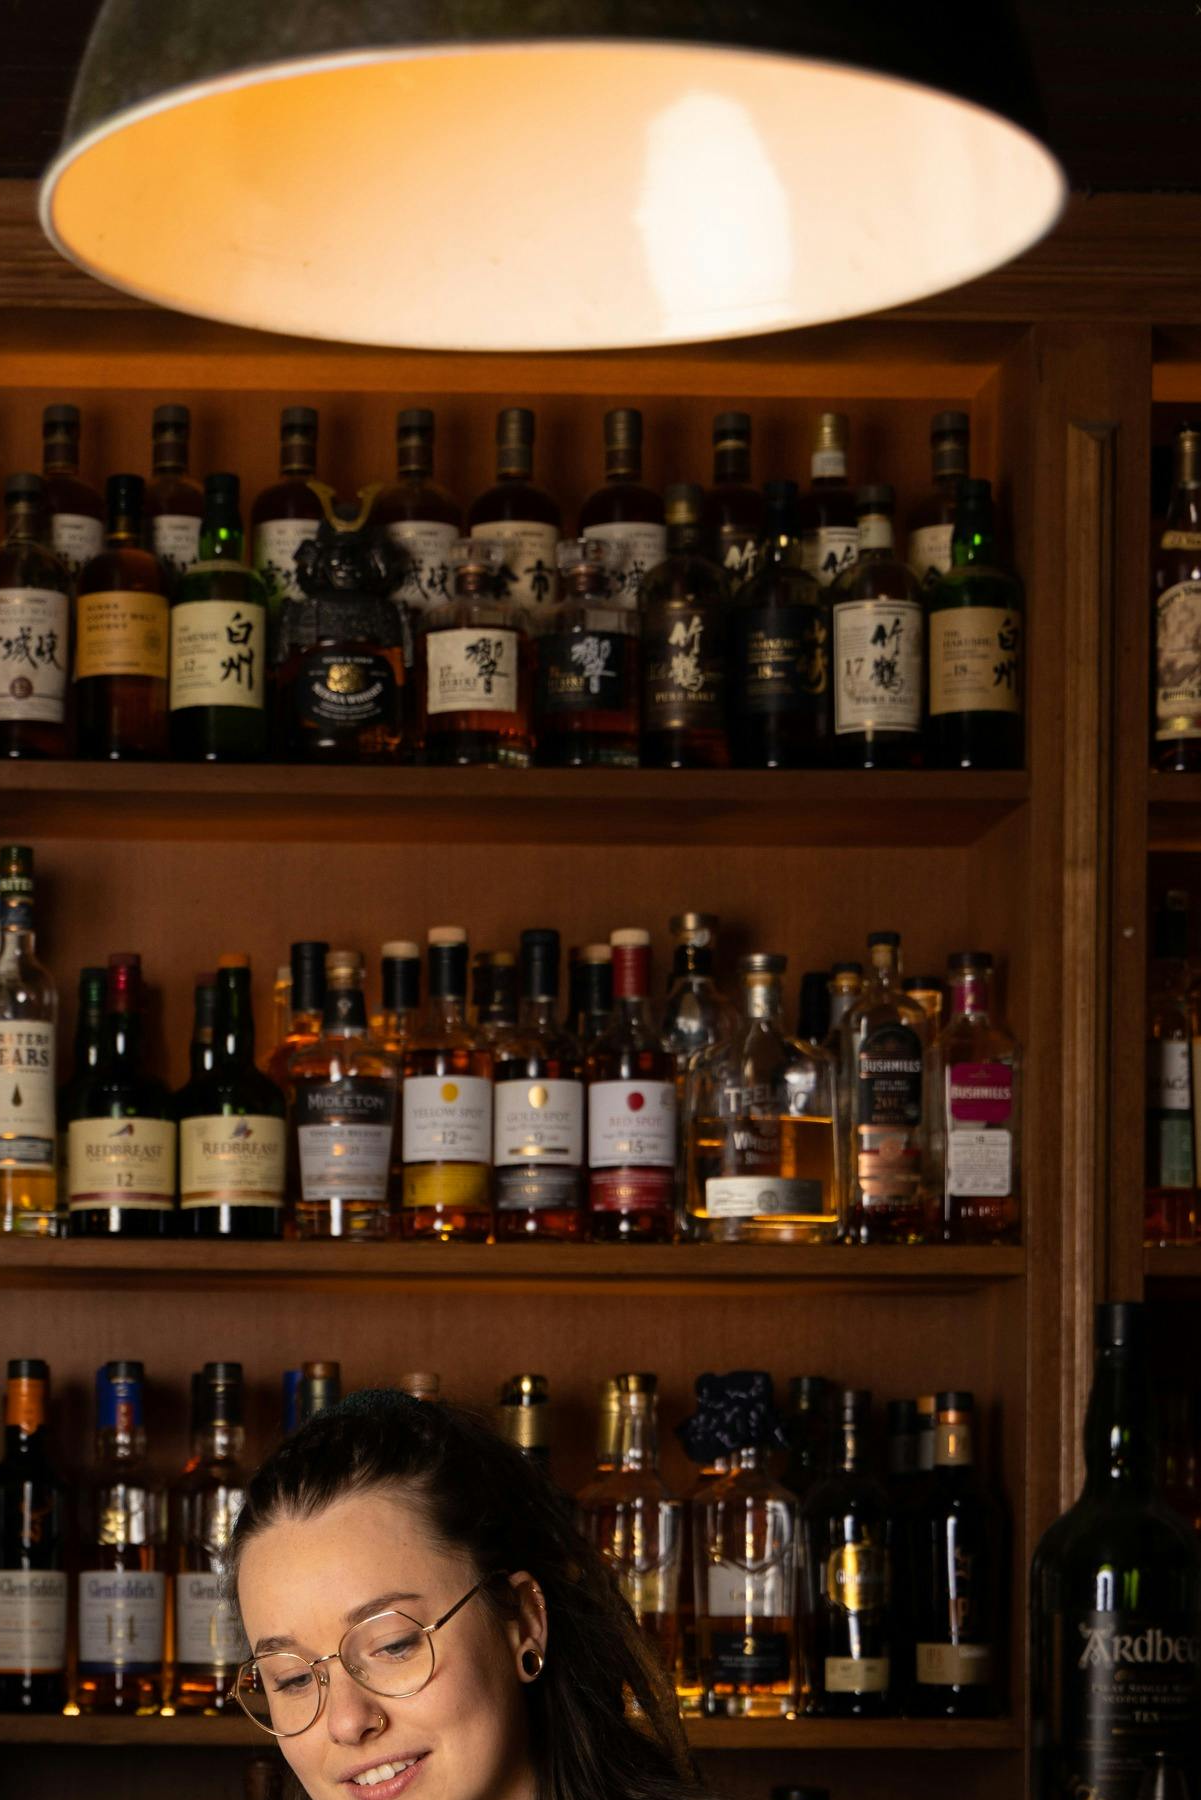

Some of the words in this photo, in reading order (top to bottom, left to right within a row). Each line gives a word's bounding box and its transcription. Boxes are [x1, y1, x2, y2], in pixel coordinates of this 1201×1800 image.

[220, 612, 255, 691] 白州
[844, 657, 865, 677] 17
[861, 1059, 922, 1073] BUSHMILLS
[307, 1090, 384, 1110] MIDLETON
[950, 1086, 1011, 1101] BUSHMILLS
[411, 1108, 453, 1119] YELLOW
[455, 1108, 485, 1119] SPOT
[507, 1111, 540, 1122] GOLD
[543, 1111, 570, 1122] SPOT
[636, 1118, 664, 1129] SPOT
[440, 1131, 457, 1145] 12
[85, 1143, 163, 1158] REDBREAST
[201, 1140, 278, 1156] REDBREAST
[115, 1172, 134, 1188] 12
[87, 1580, 155, 1599] Glenfiddich
